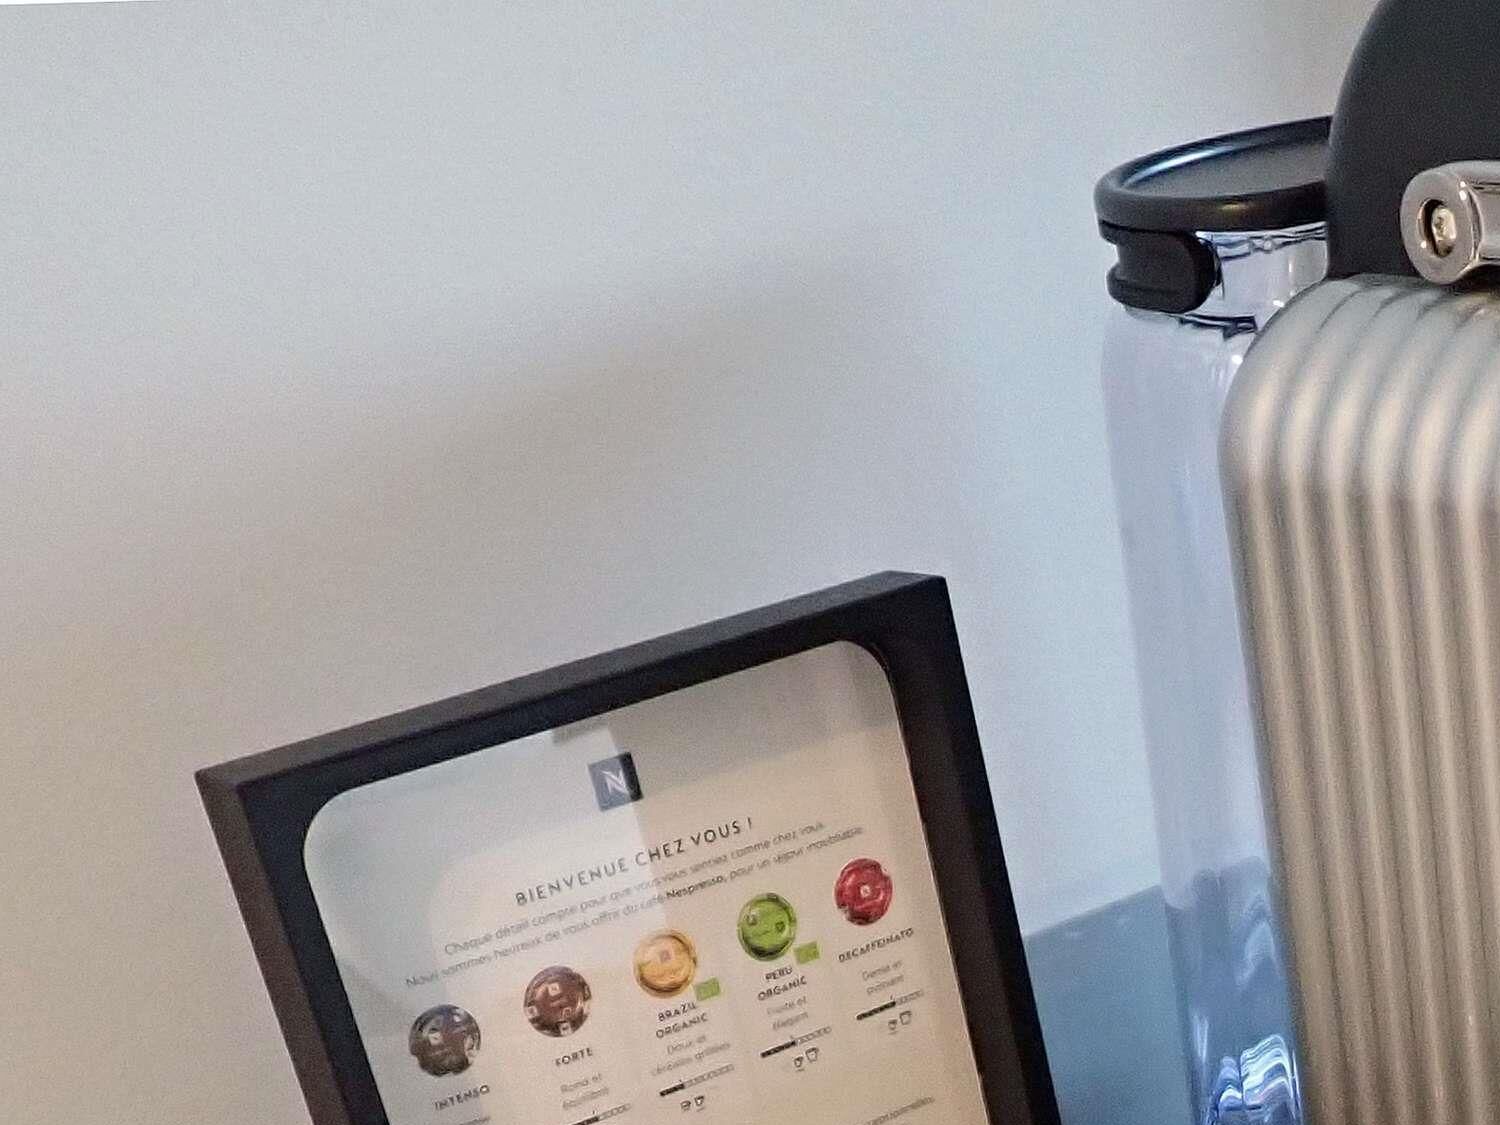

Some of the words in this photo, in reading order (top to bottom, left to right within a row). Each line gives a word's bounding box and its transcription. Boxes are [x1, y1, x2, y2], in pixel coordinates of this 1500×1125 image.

[514, 857, 627, 905] BIENVENUE
[634, 839, 683, 866] CHEZ
[690, 820, 740, 848] VOUS
[757, 976, 805, 1000] ORGANIC
[655, 1012, 707, 1038] ORGANIC
[555, 1046, 592, 1066] FORTE
[434, 1083, 489, 1111] INTENSO
